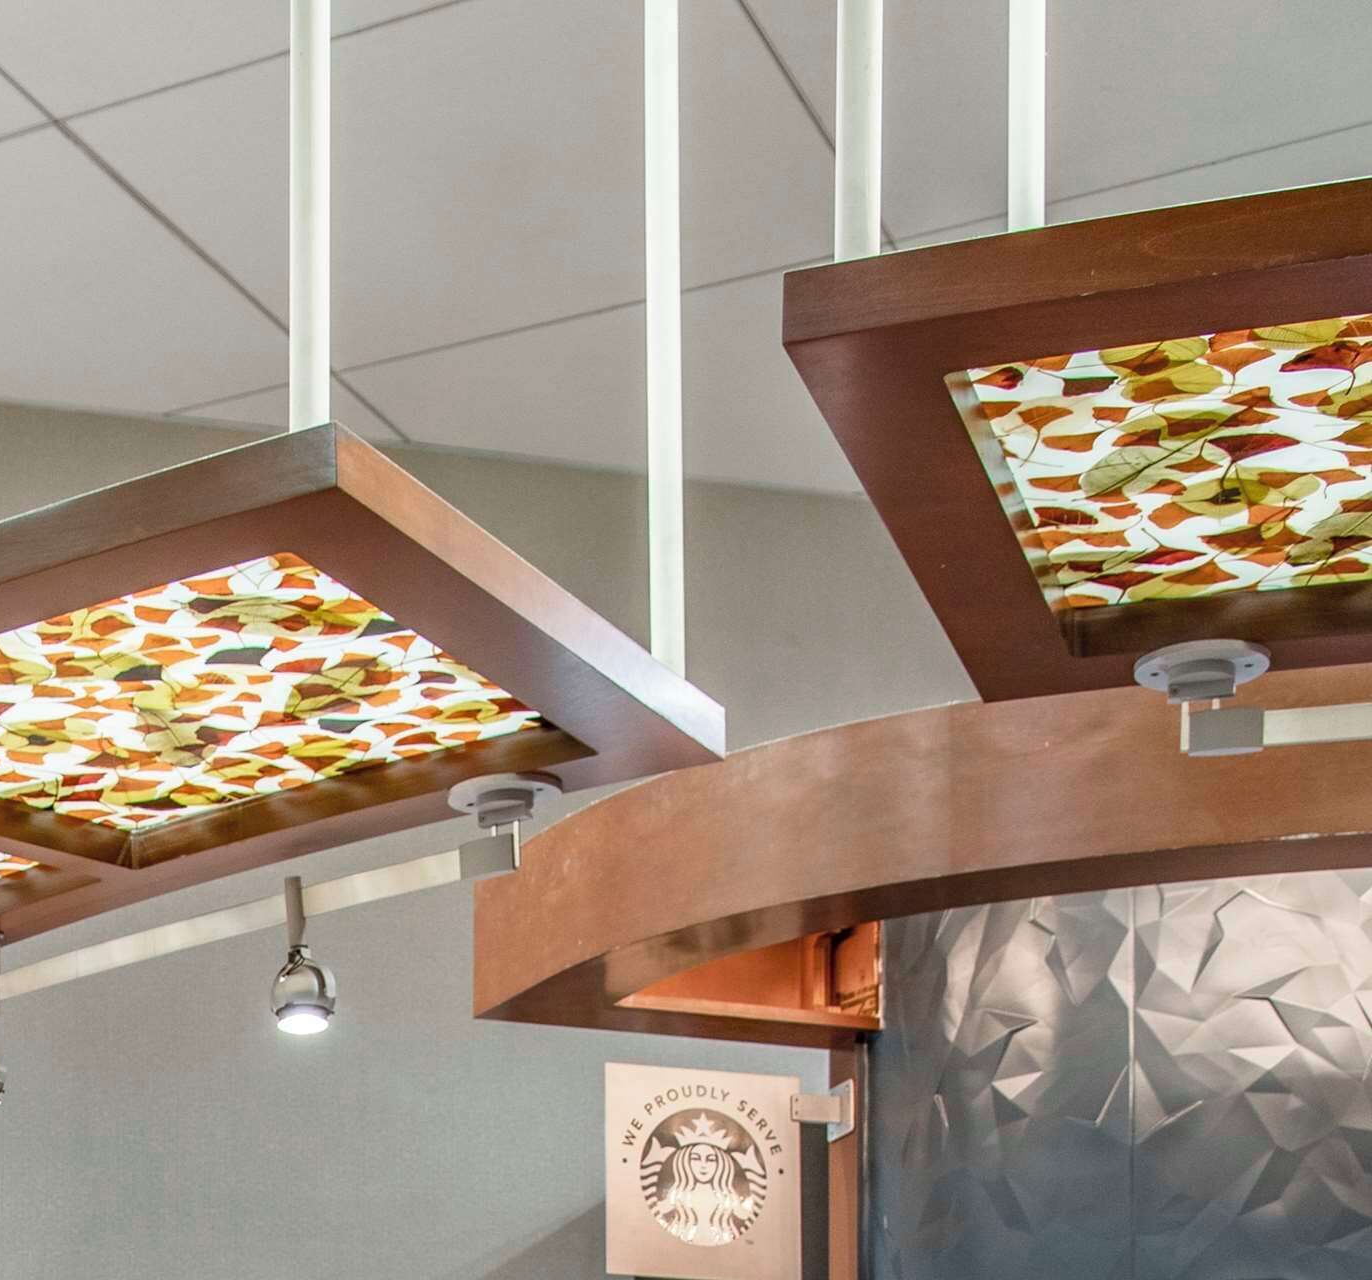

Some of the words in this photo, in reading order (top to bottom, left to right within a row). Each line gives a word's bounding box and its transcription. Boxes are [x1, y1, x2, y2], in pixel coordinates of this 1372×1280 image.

[622, 1118, 644, 1147] WE
[643, 1084, 731, 1116] PROUDLY
[736, 1099, 783, 1156] SERVE
